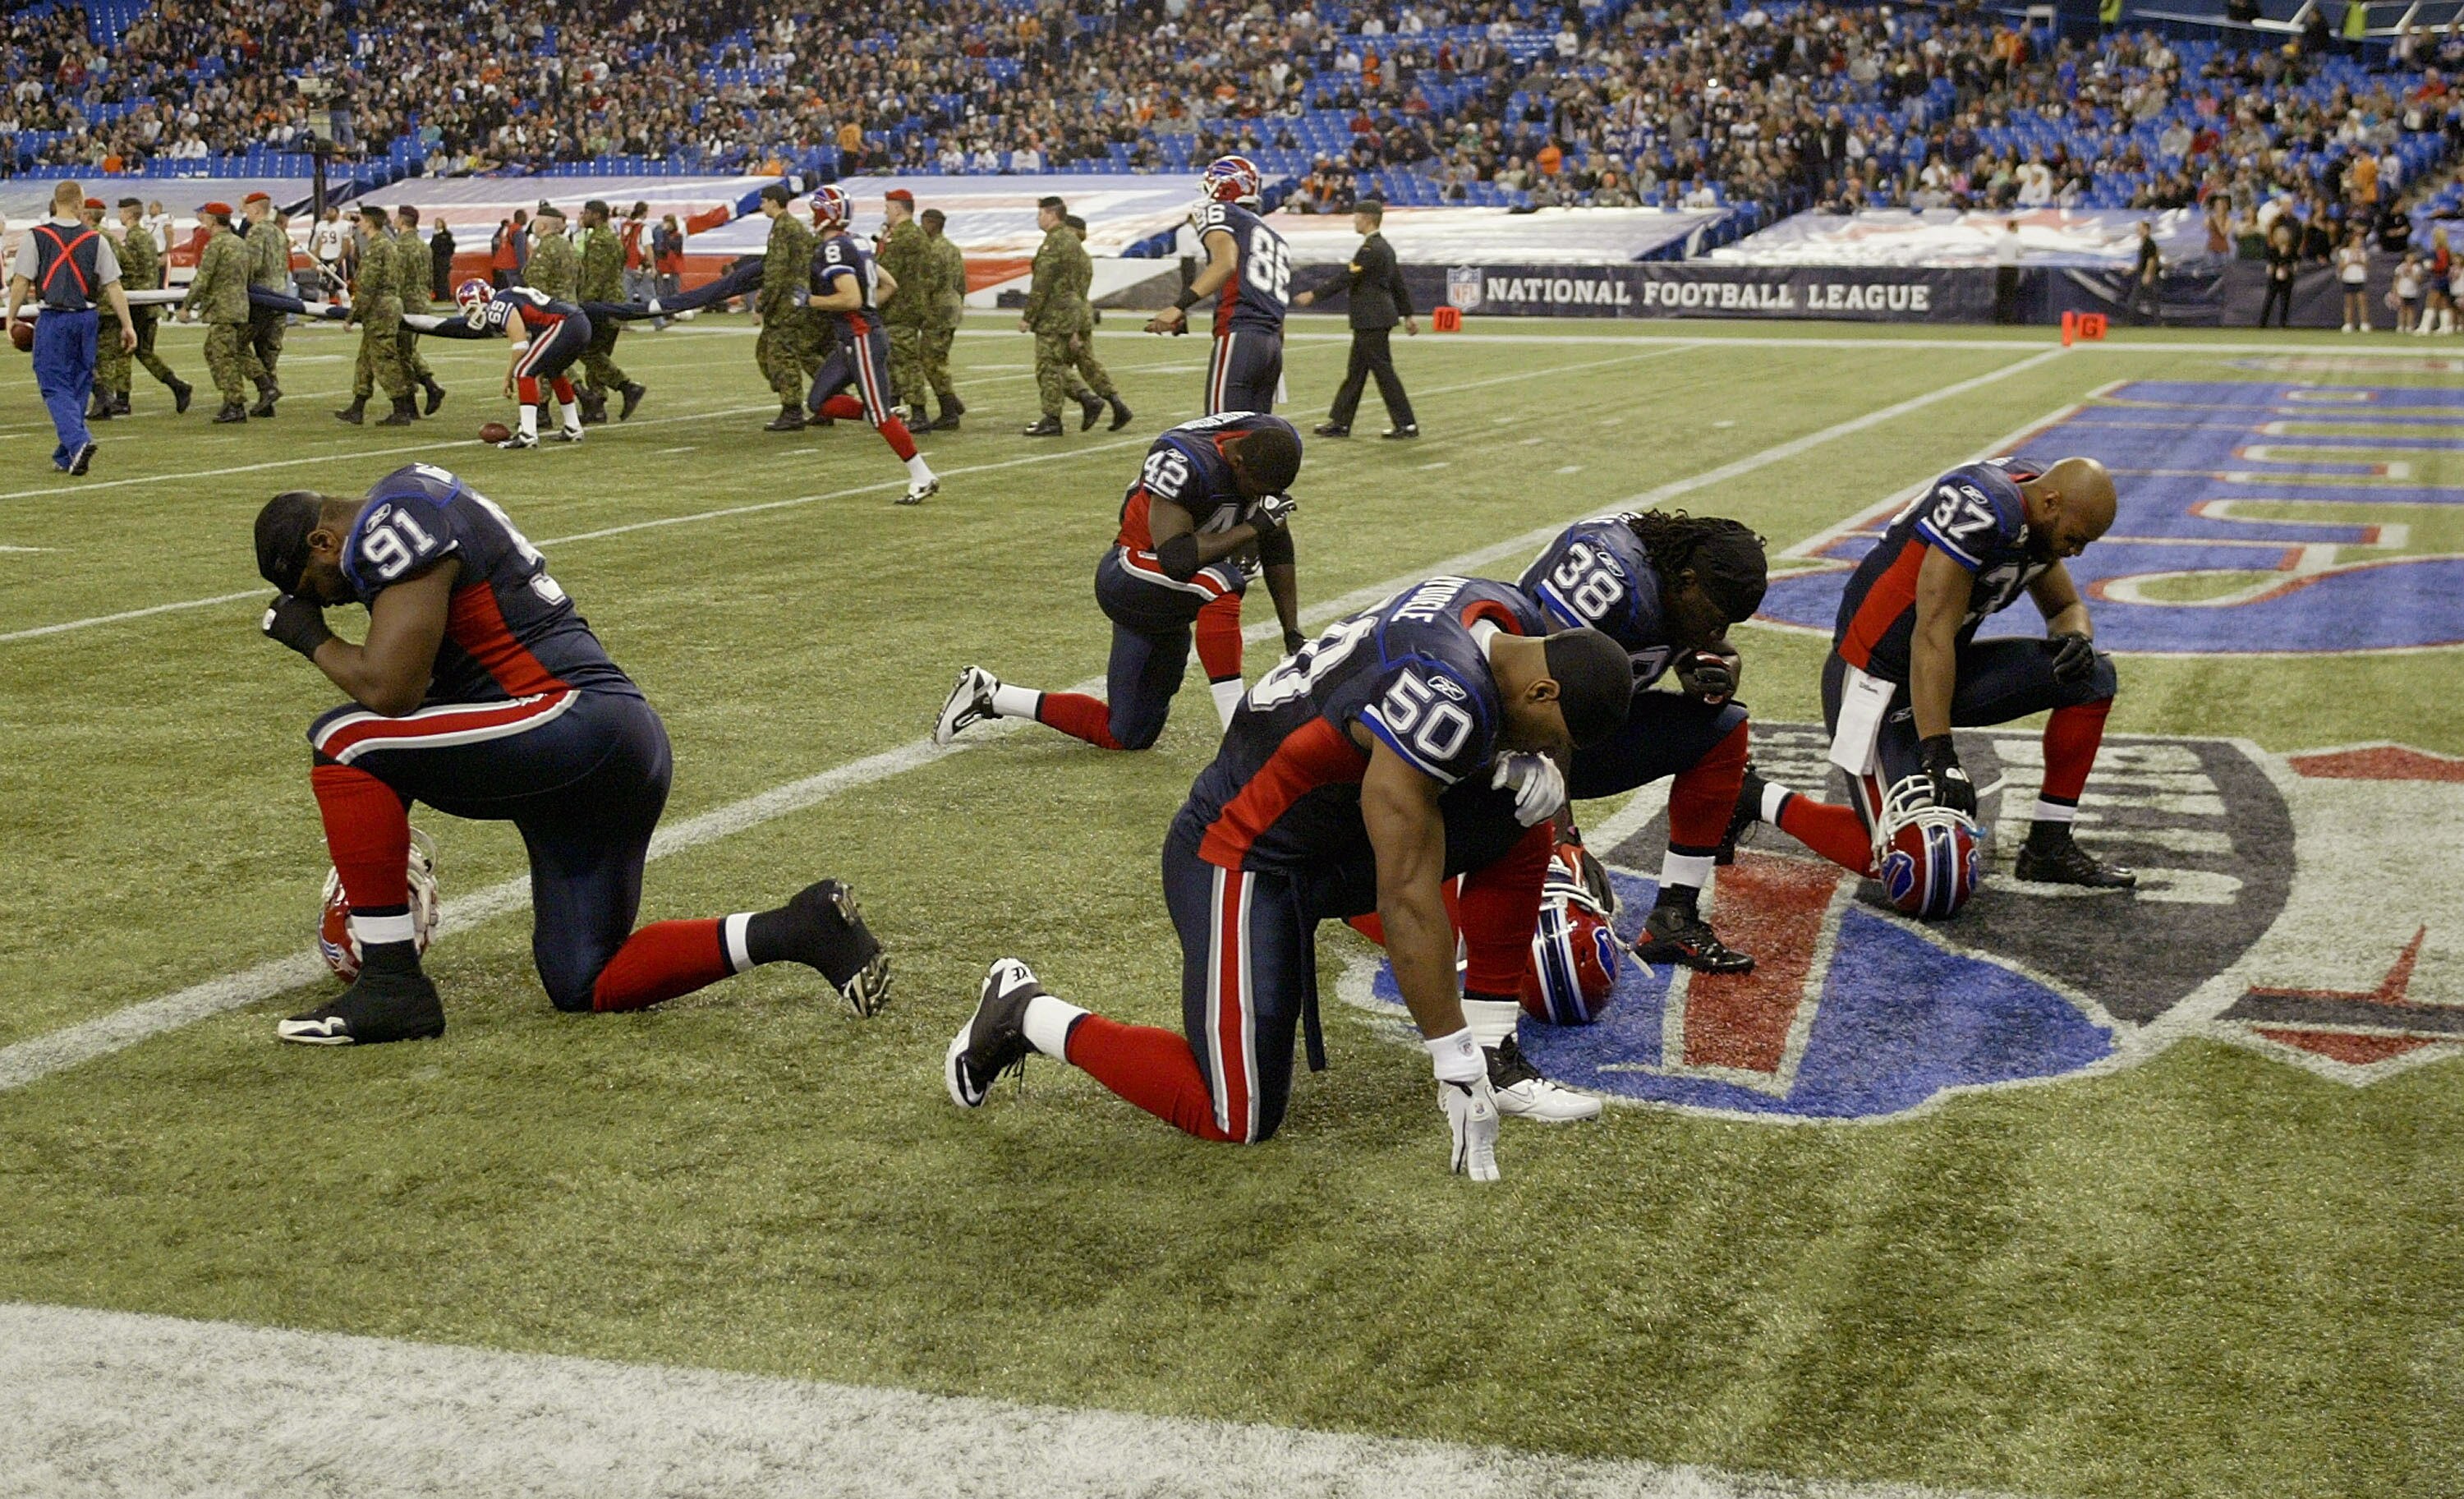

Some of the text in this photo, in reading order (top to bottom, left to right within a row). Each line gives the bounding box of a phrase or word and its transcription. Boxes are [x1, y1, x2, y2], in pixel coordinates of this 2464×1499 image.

[321, 231, 337, 244] 59
[825, 245, 841, 263] 8
[1486, 278, 1929, 311] NATIONAL FOOTBALL LEAGUE
[1437, 311, 1455, 329] 10
[2081, 317, 2098, 337] G
[1142, 450, 1189, 498] 42
[1933, 484, 1996, 540] 37
[361, 507, 439, 580] 91
[1552, 541, 1625, 620] 38
[1381, 667, 1474, 761] 50
